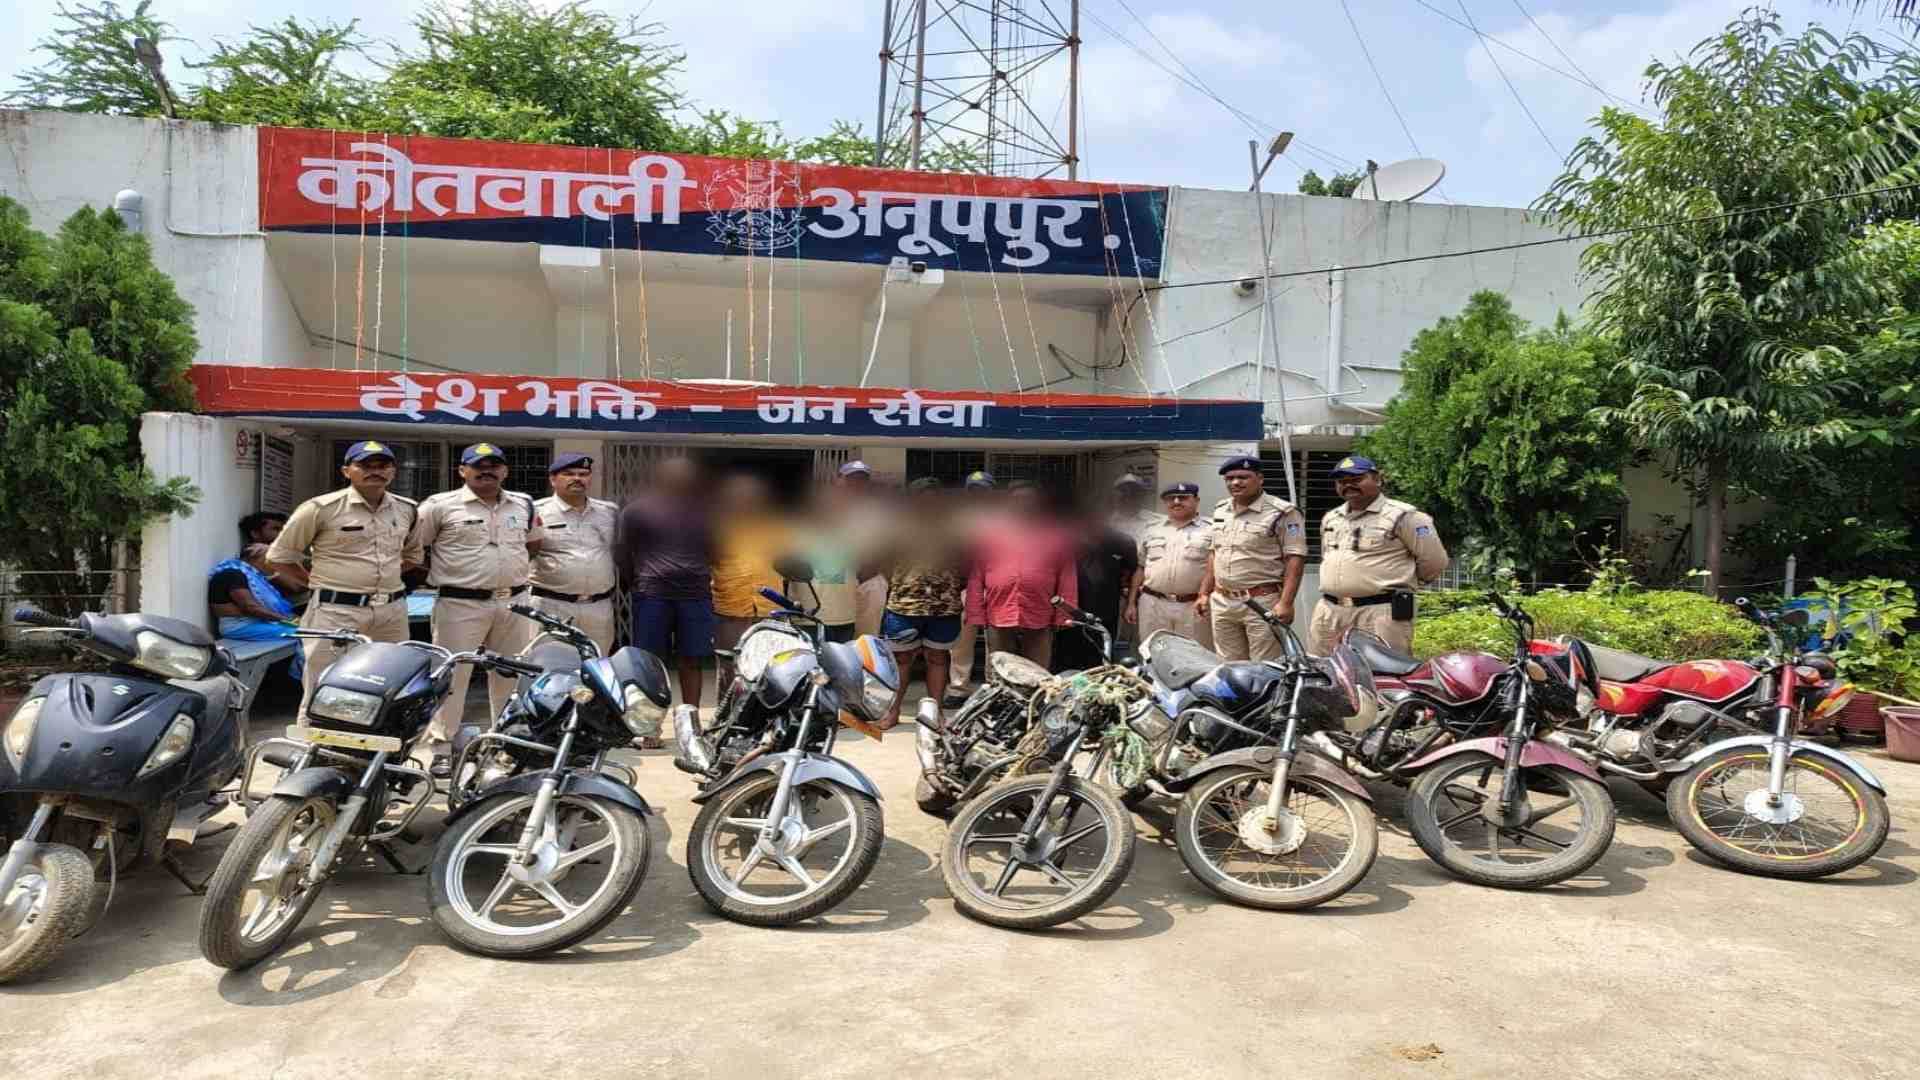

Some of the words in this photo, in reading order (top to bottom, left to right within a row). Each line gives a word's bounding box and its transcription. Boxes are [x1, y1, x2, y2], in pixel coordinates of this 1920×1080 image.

[296, 142, 698, 225] कोतवाली
[359, 374, 508, 422] देश
[516, 381, 662, 422] भक्ति
[757, 395, 857, 424] जन
[868, 389, 997, 428] सेवा
